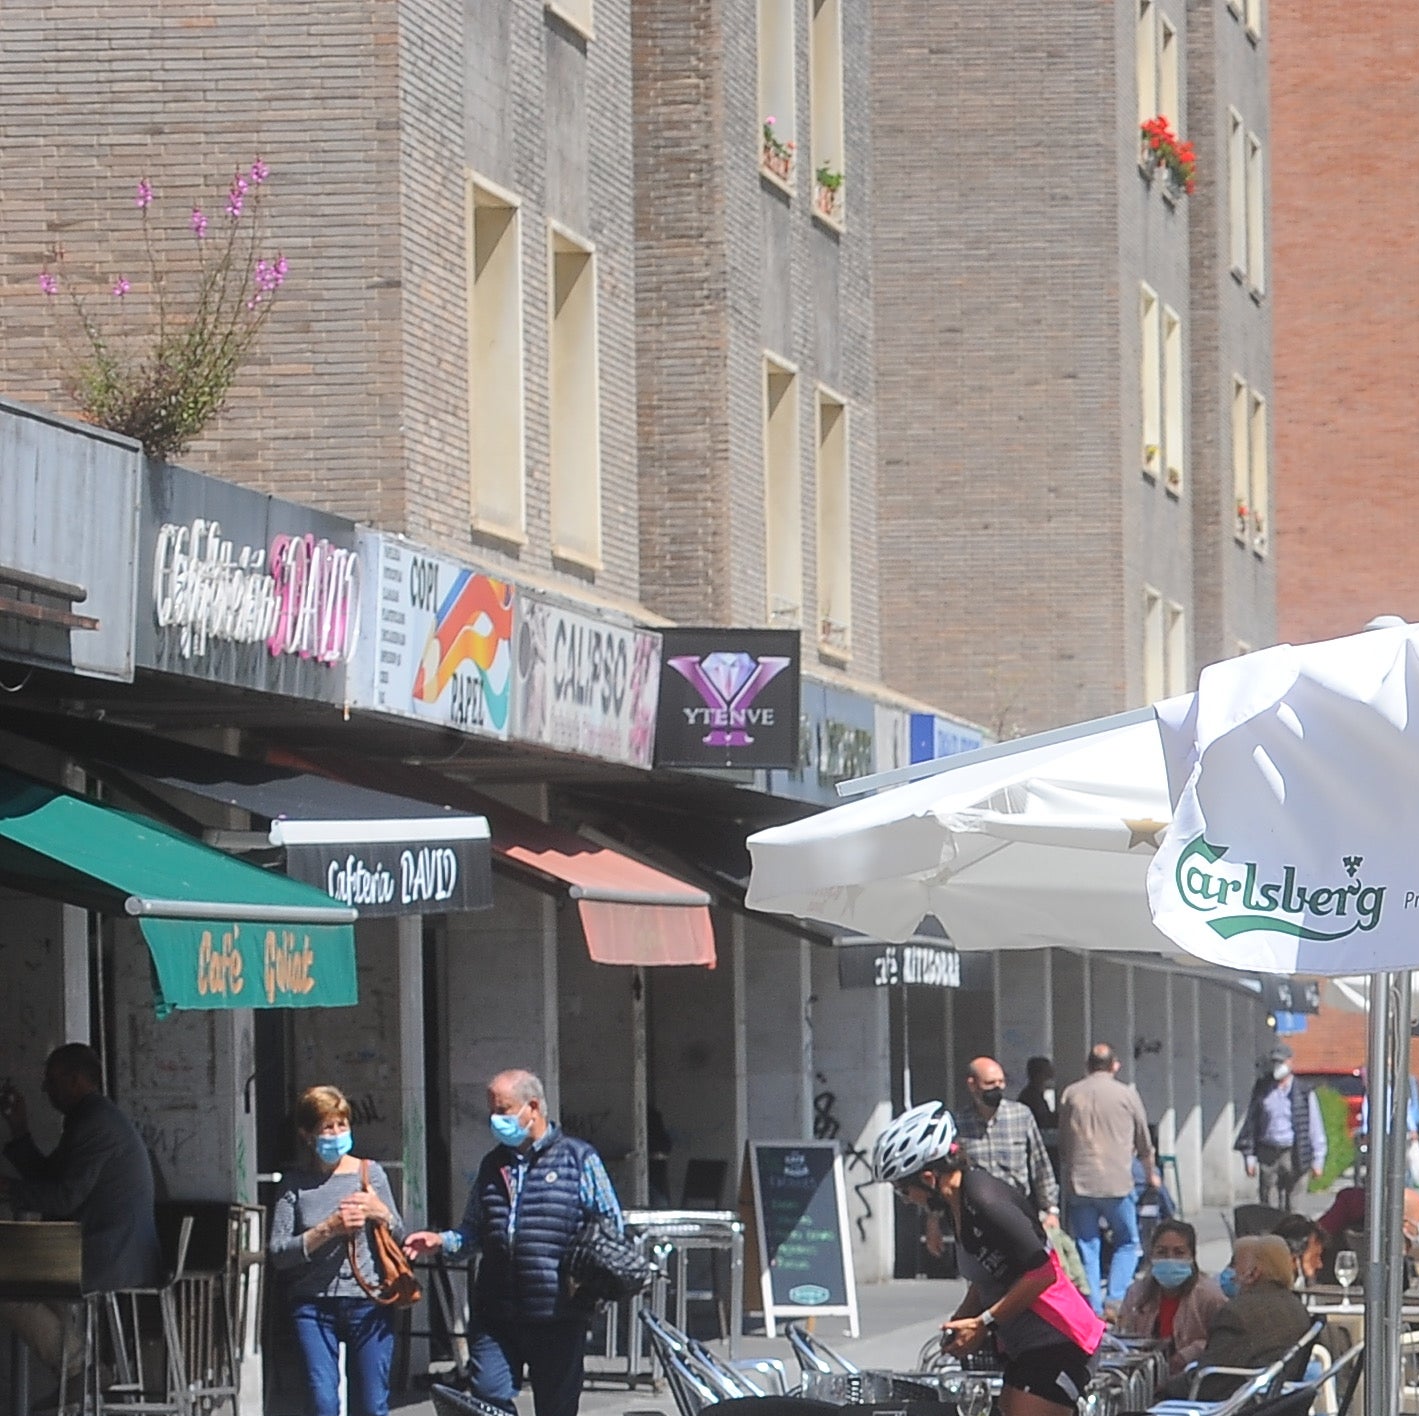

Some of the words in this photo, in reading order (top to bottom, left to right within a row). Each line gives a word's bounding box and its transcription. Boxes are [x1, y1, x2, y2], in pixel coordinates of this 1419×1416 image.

[553, 618, 628, 719] CALIPSO
[683, 708, 775, 726] YTENVE
[400, 846, 457, 904] DAVID
[1175, 833, 1388, 932] Carlsberg
